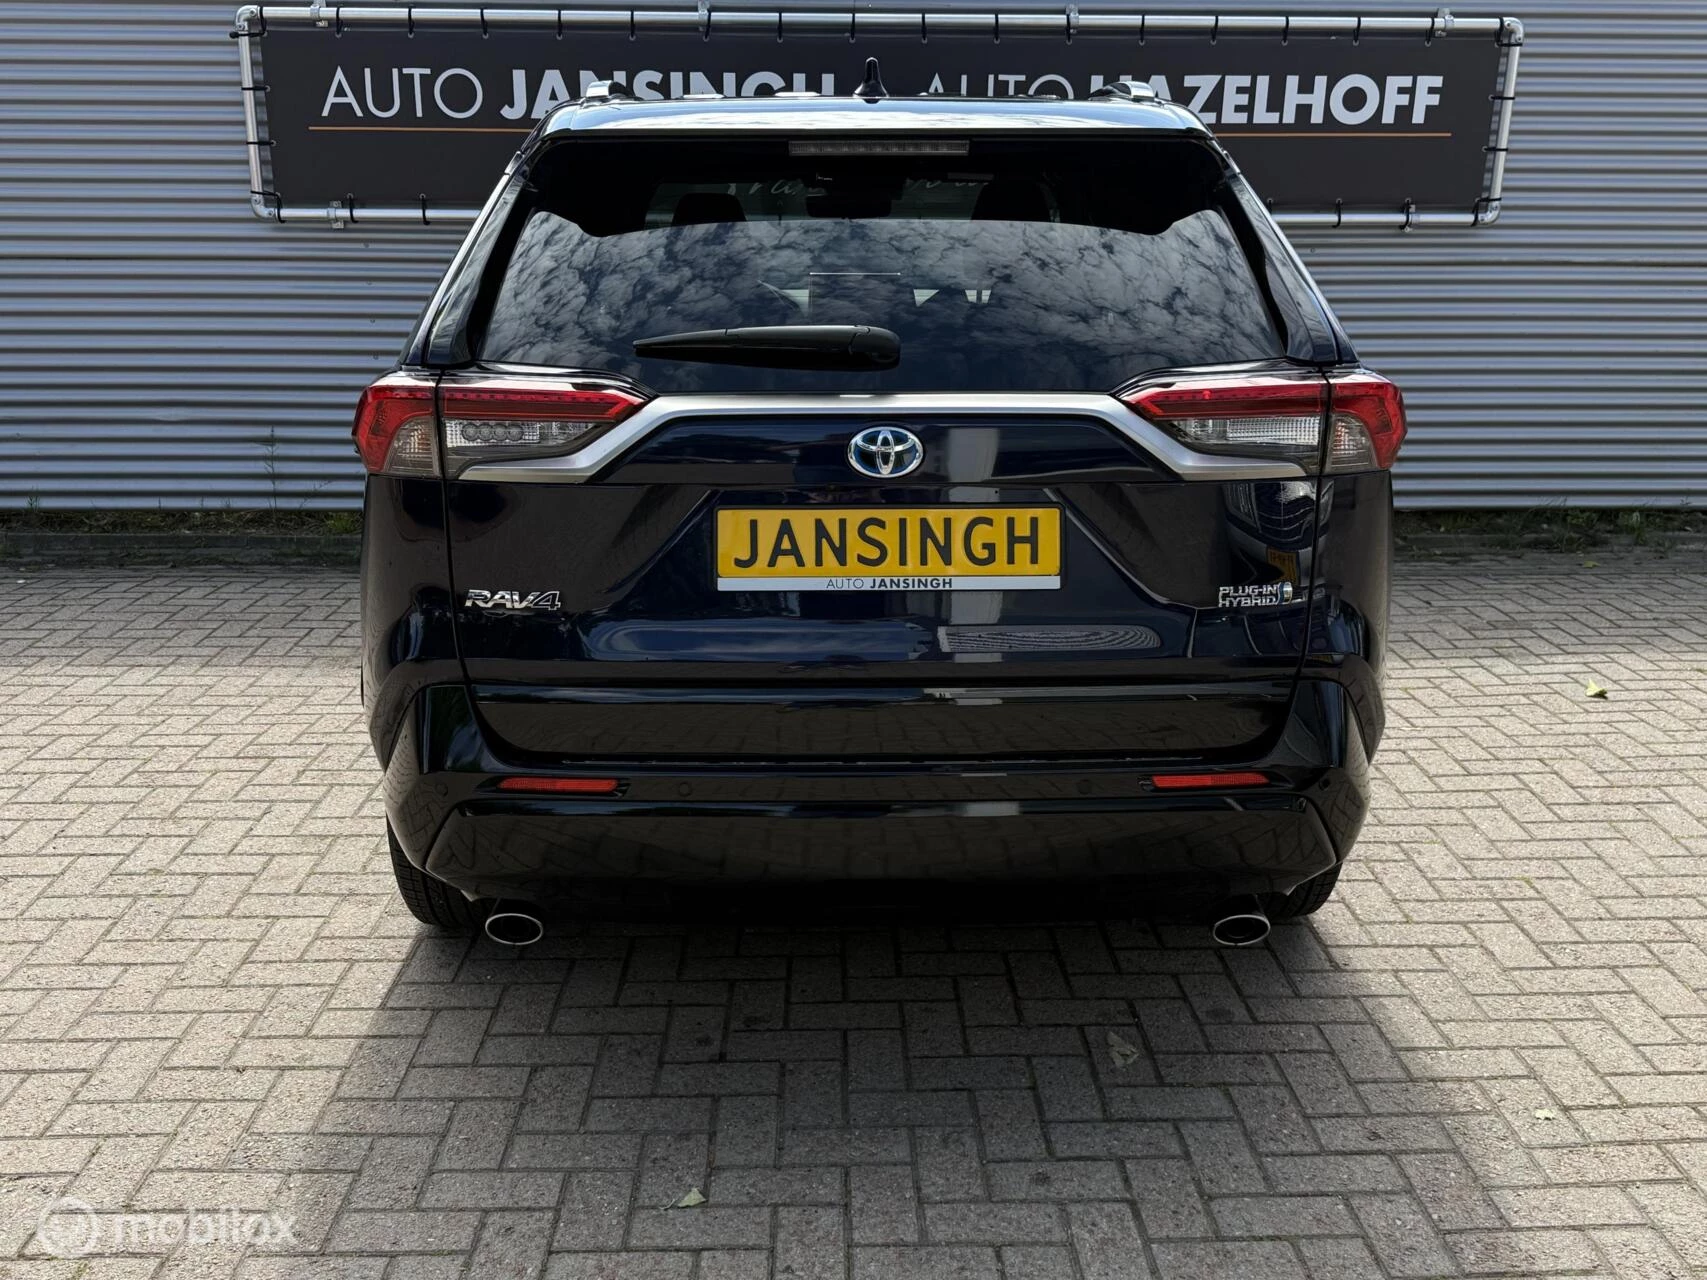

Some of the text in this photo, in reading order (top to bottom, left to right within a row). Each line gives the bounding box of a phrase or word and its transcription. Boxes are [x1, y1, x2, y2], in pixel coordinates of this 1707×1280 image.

[321, 65, 483, 119] AUTO
[733, 516, 1040, 569] JANSINGH
[826, 577, 953, 589] AUTO JANSINGH
[1219, 584, 1280, 597] PLUG-IN
[464, 589, 561, 611] RAV4
[1218, 595, 1279, 608] HYBRID
